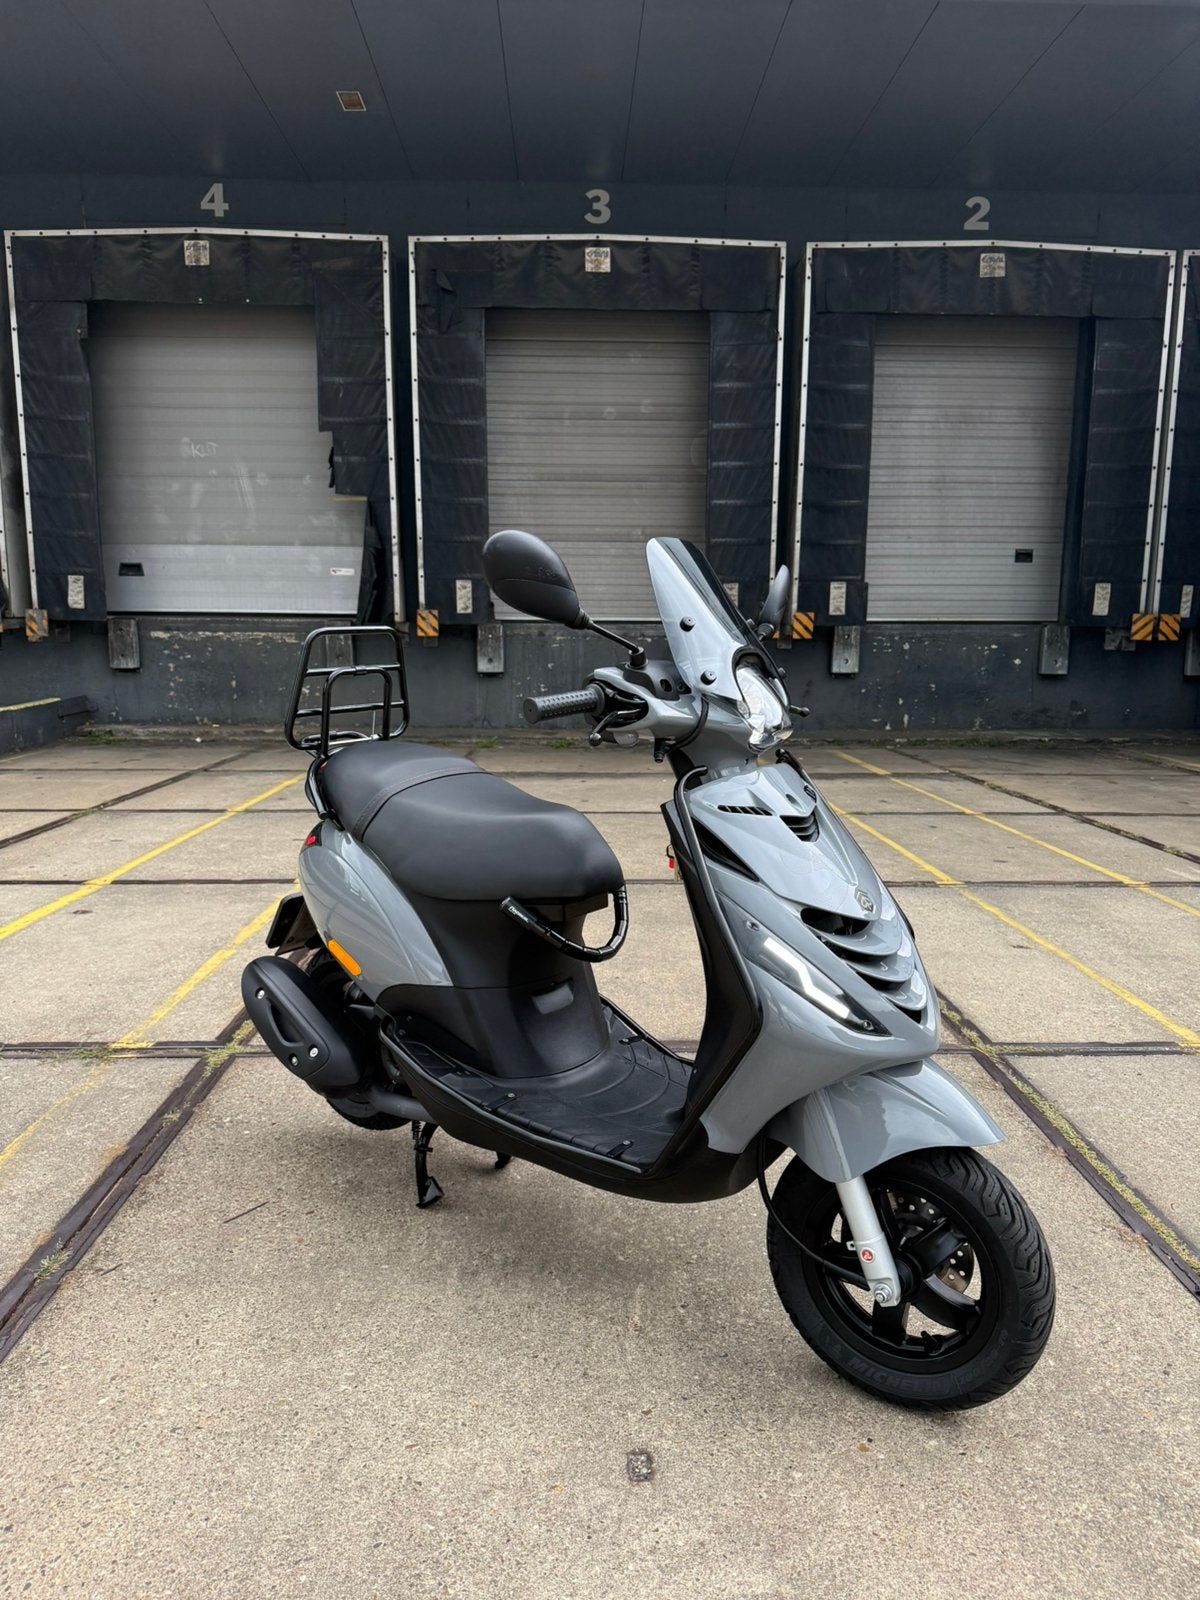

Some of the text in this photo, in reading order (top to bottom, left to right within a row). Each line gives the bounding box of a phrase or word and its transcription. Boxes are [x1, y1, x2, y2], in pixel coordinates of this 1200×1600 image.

[200, 182, 230, 217] 4
[583, 188, 612, 225] 3
[963, 195, 991, 231] 2
